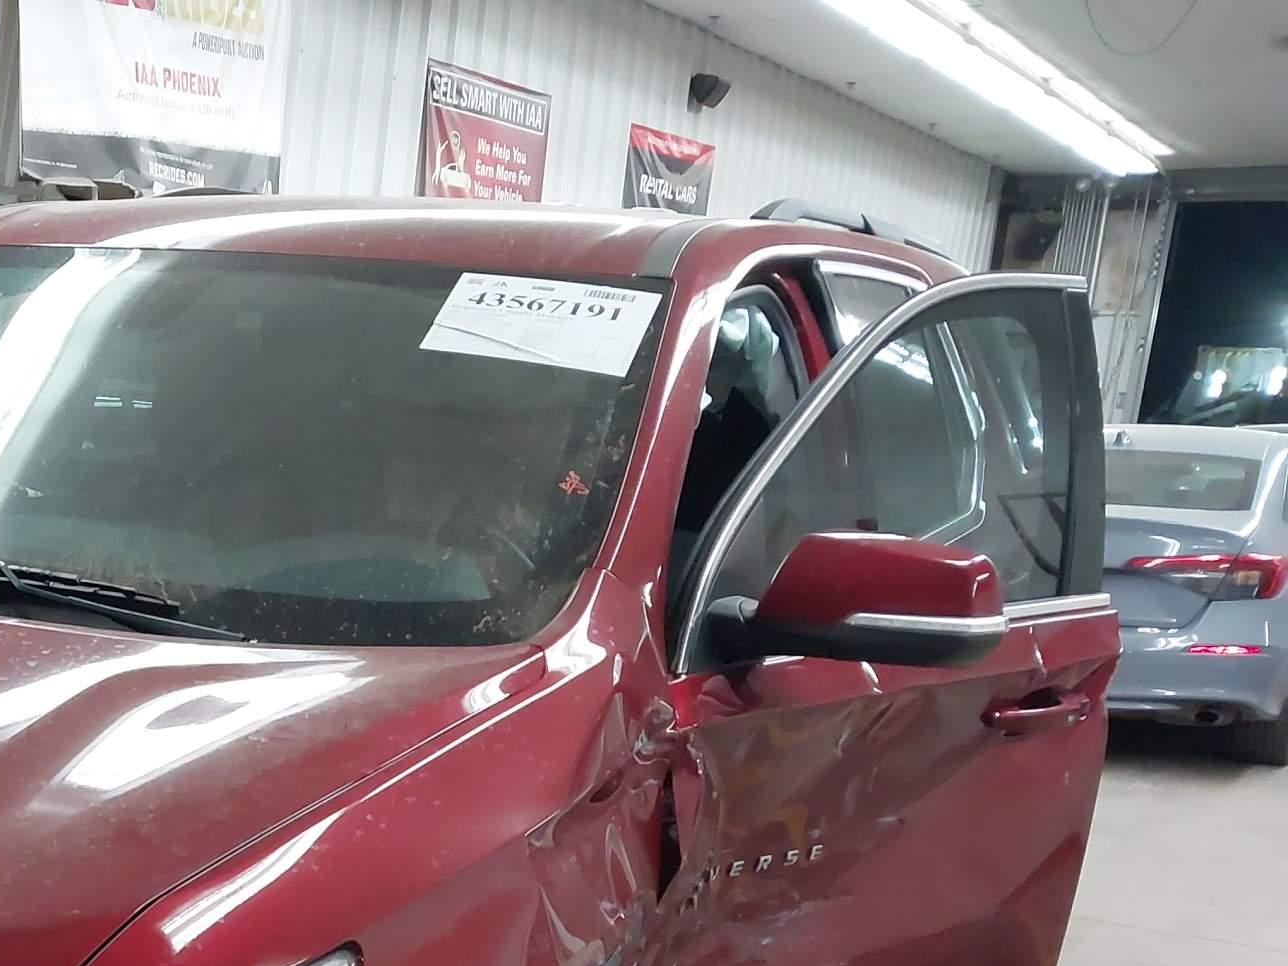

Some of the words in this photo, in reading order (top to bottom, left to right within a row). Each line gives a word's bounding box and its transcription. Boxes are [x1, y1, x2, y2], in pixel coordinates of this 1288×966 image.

[191, 31, 198, 49] A
[198, 32, 235, 56] POWERSPORT
[237, 40, 265, 61] AUCTION
[135, 61, 158, 88] IAA
[163, 67, 222, 98] PHOENIX
[432, 75, 459, 105] SELL
[460, 82, 499, 115] SMART
[499, 94, 525, 123] WITH
[525, 103, 543, 129] IAA
[477, 137, 490, 156] We
[492, 141, 511, 164] Help
[513, 146, 527, 165] You
[148, 161, 205, 187] RECRIDES.COM
[475, 159, 495, 178] Earn
[496, 163, 517, 184] More
[518, 169, 532, 186] For
[474, 180, 492, 199] Your
[495, 184, 523, 201] Vehicle
[639, 173, 674, 200] RENTAL
[675, 185, 697, 205] CARS
[467, 291, 623, 321] 43567191
